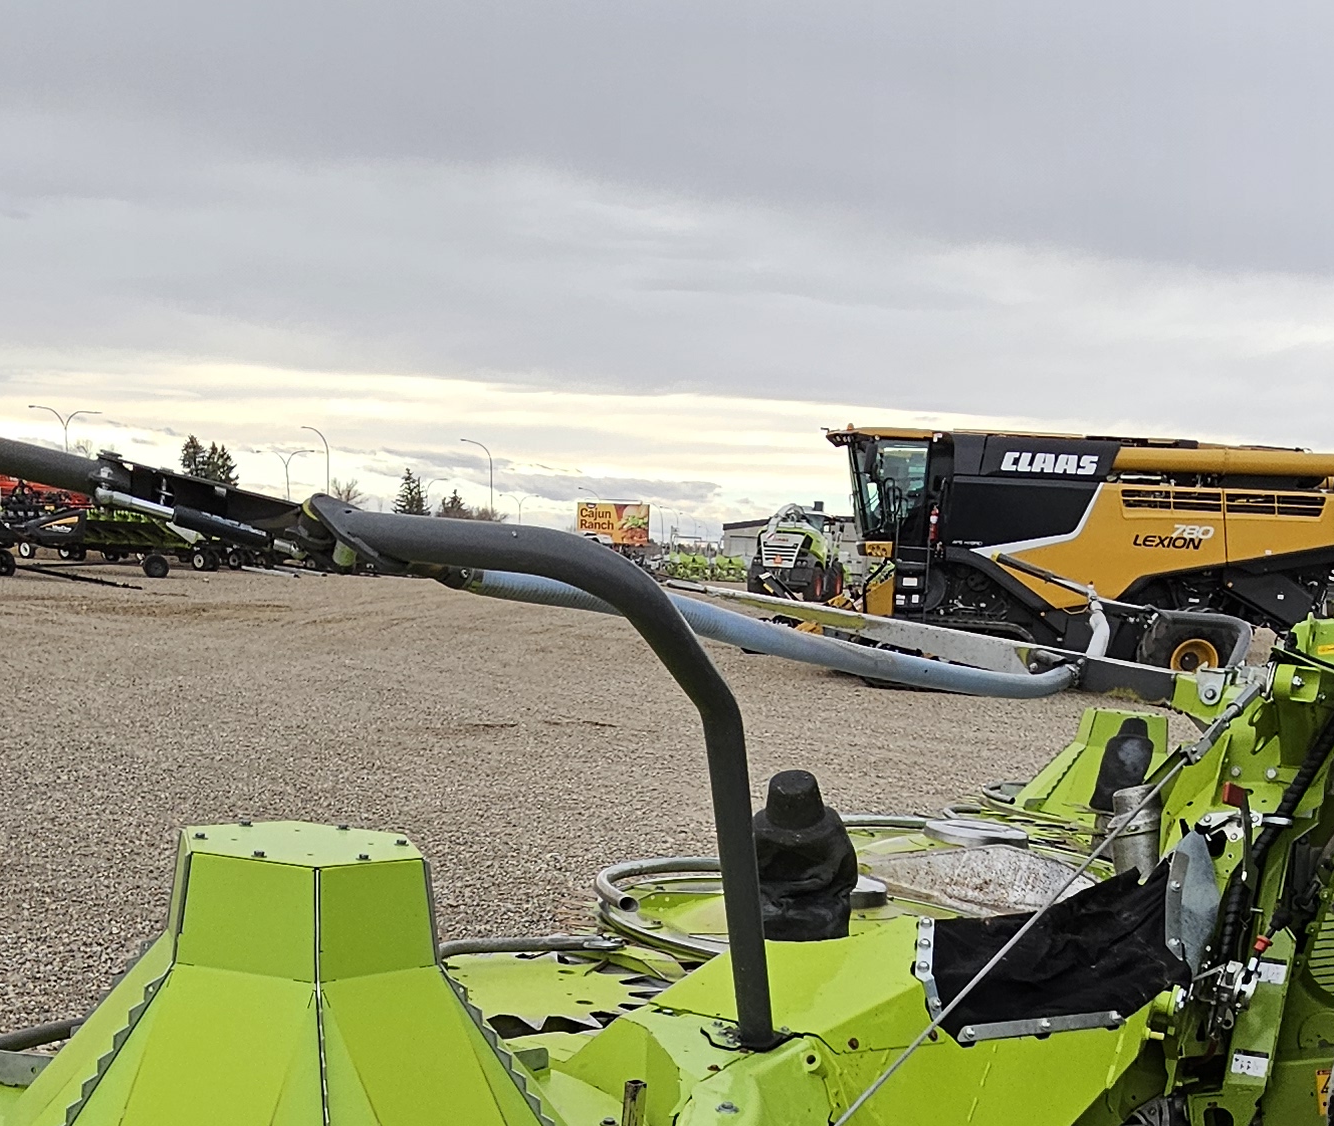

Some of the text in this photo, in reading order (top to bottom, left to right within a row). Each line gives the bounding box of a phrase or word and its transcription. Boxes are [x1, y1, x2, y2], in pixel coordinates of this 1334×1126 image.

[1001, 452, 1099, 475] CLAAS
[580, 507, 612, 520] Cajun
[580, 519, 615, 530] Ranch
[1171, 524, 1215, 540] 780
[1133, 534, 1203, 550] LEXION
